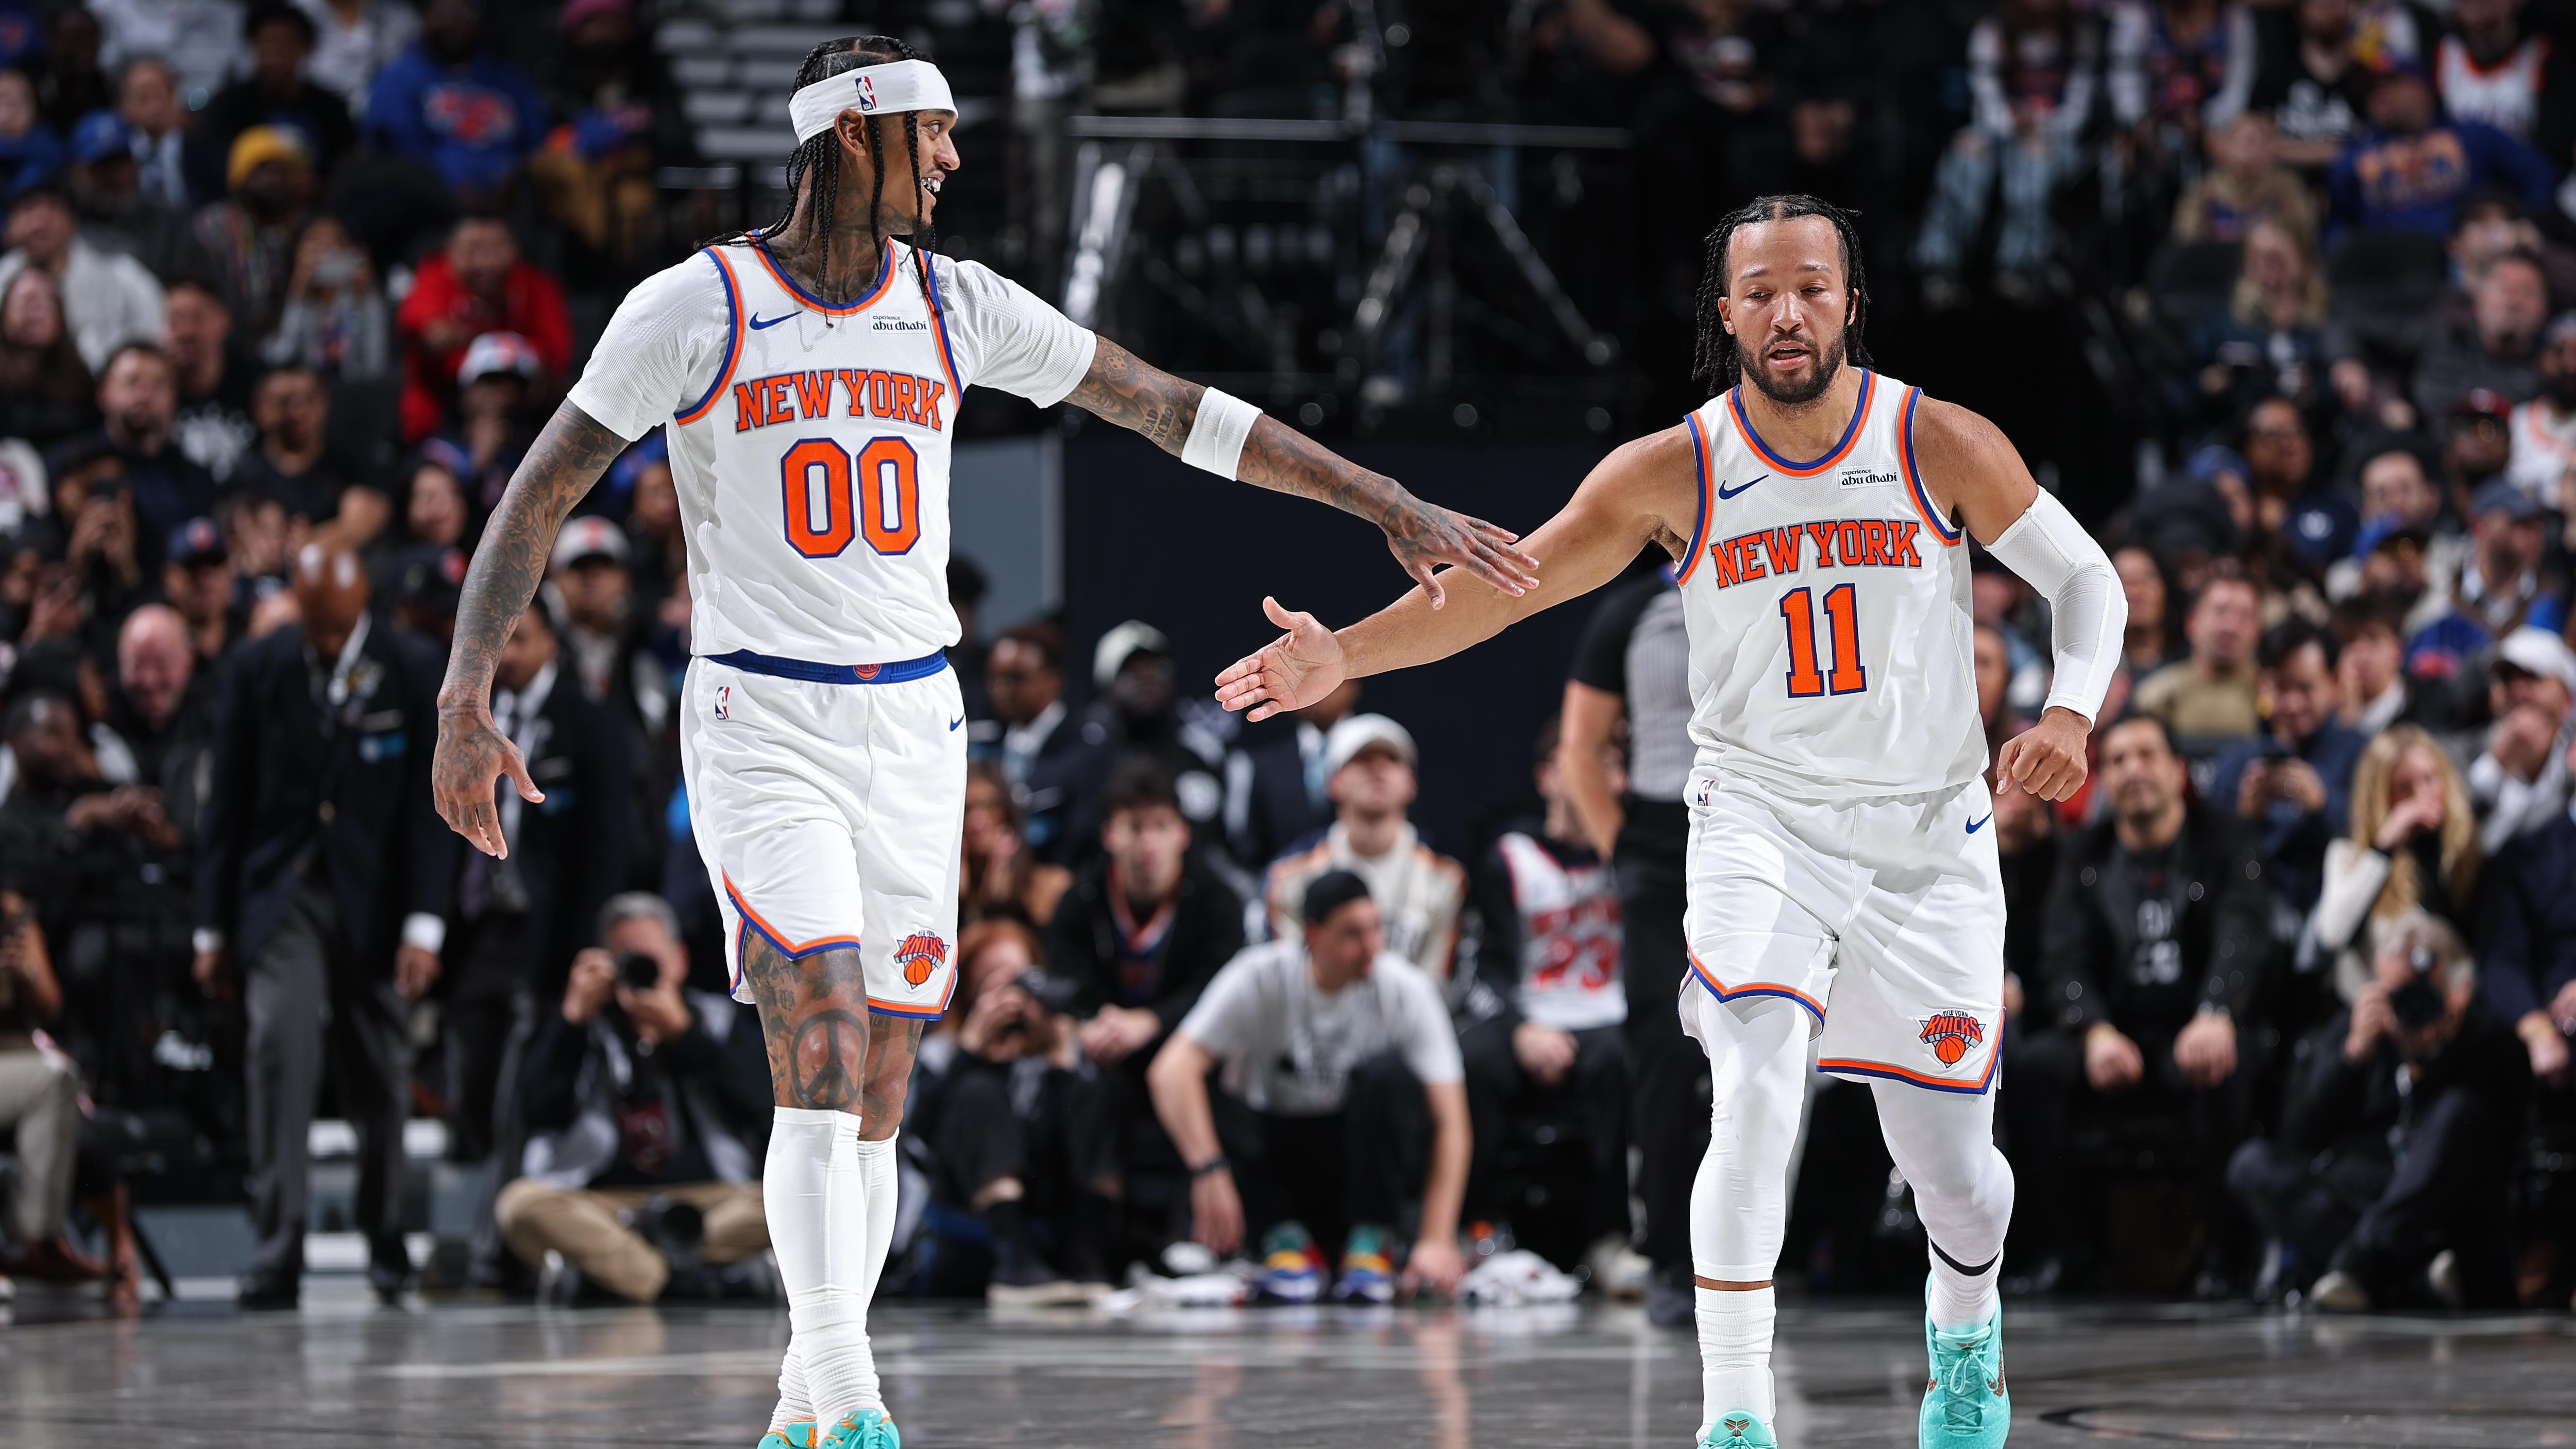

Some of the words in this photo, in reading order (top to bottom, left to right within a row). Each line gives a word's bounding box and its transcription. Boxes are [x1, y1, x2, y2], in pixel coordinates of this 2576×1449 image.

[873, 321, 893, 330] abu
[895, 320, 927, 330] dhabi
[732, 369, 835, 435] NEW
[836, 368, 945, 435] YORK
[1842, 475, 1863, 485] abu
[1865, 472, 1897, 483] dhabi
[781, 436, 921, 558] 00
[1709, 523, 1803, 591] NEW
[1804, 518, 1923, 570] YORK
[1779, 583, 1867, 698] 11
[893, 934, 945, 963] KNICKS
[1919, 1014, 1983, 1042] KNICKS
[1955, 1010, 1969, 1018] YORK
